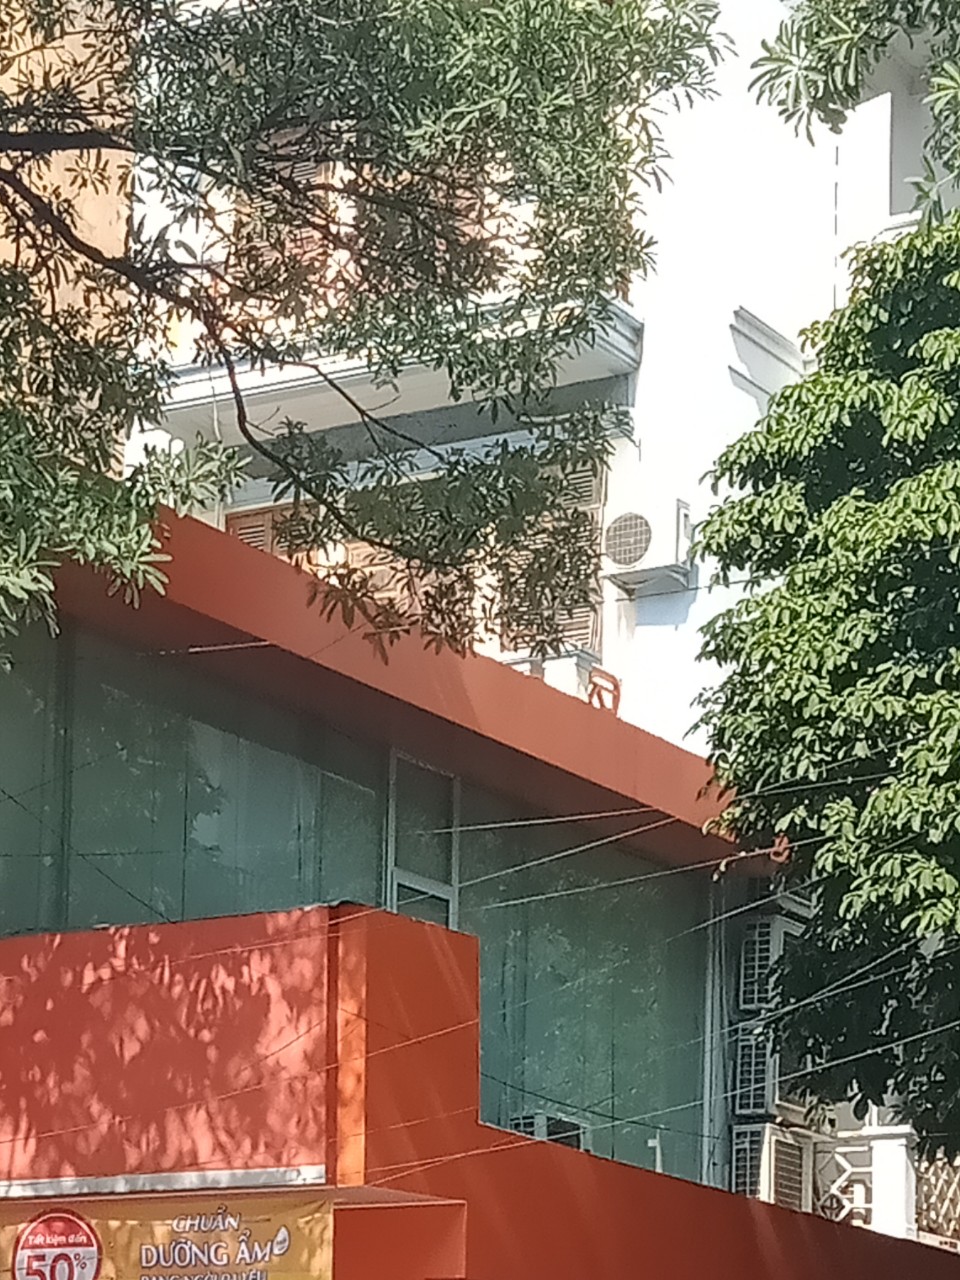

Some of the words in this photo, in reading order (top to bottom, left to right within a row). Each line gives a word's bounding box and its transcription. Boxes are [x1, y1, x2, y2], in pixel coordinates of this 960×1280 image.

[172, 1203, 241, 1232] CHUẨN
[140, 1237, 229, 1268] DƯỠNG
[235, 1229, 272, 1265] ẨM
